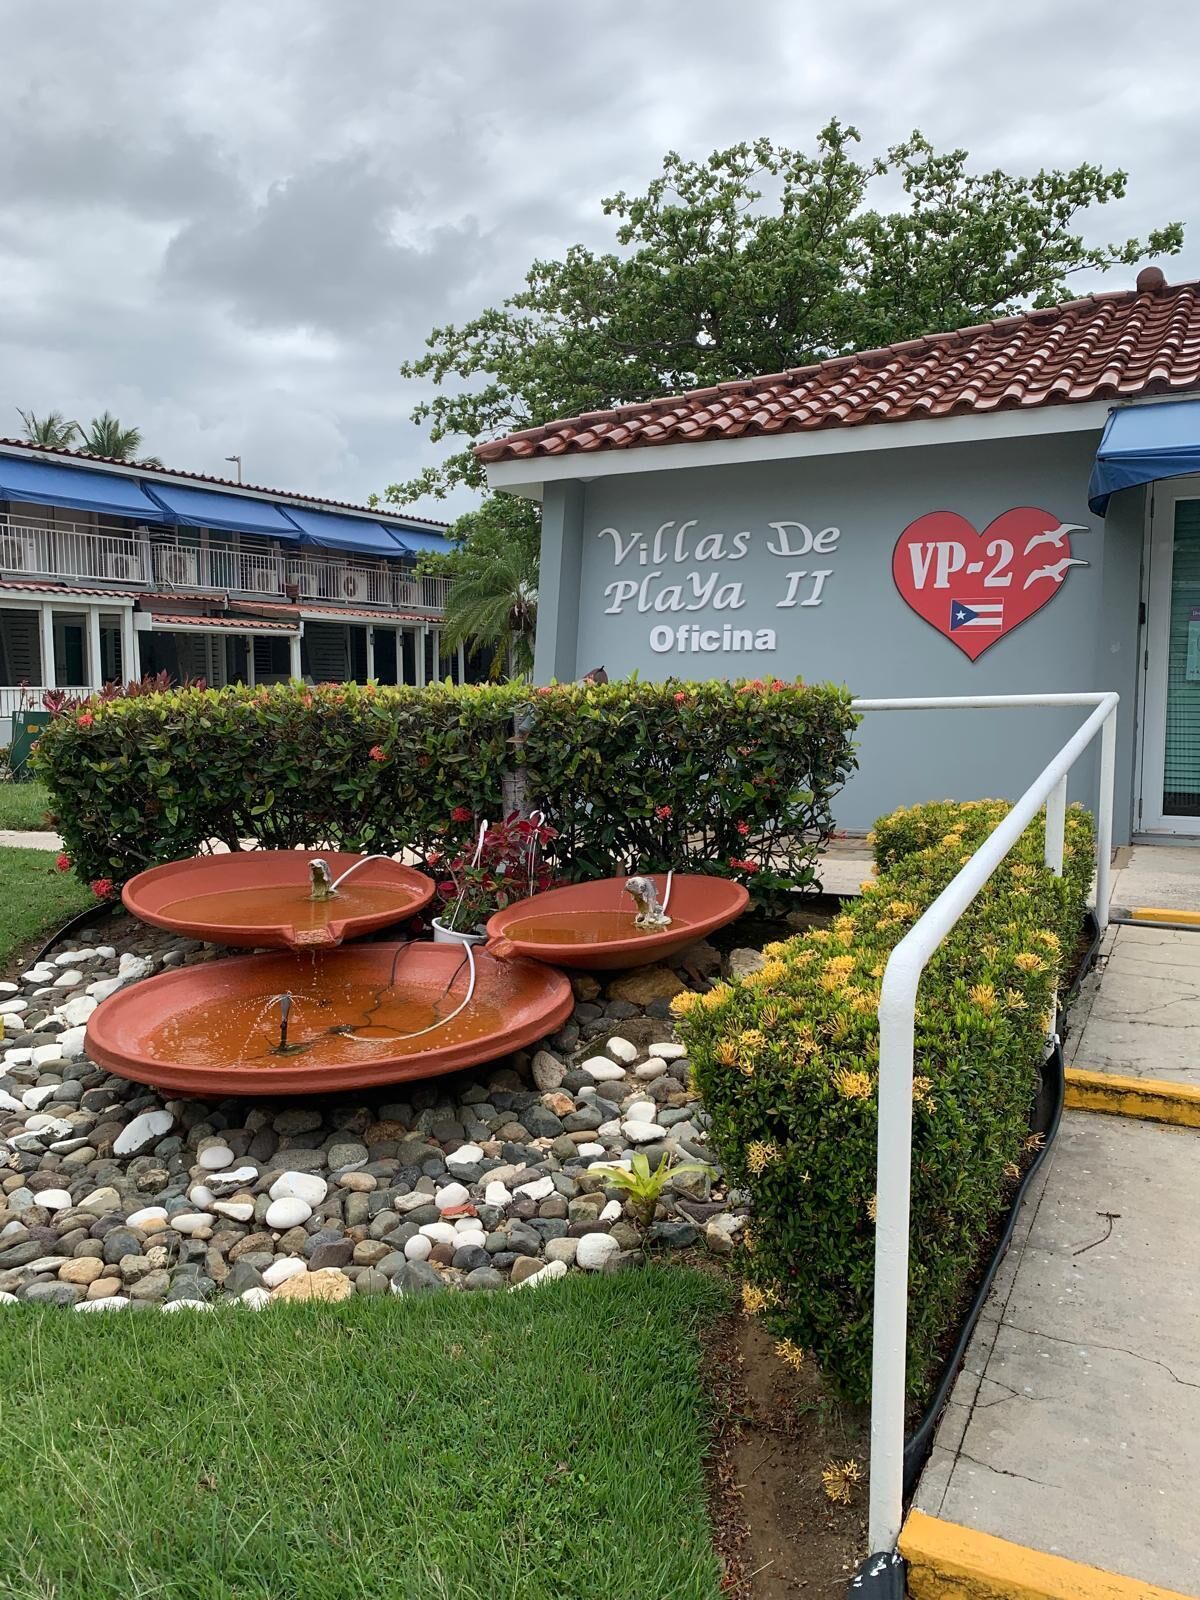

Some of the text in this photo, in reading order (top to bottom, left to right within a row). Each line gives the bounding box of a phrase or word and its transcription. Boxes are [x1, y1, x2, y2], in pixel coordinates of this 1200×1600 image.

[598, 519, 841, 566] Villas De
[907, 539, 1015, 590] VP-2
[775, 569, 834, 608] II
[649, 624, 777, 653] Oficina
